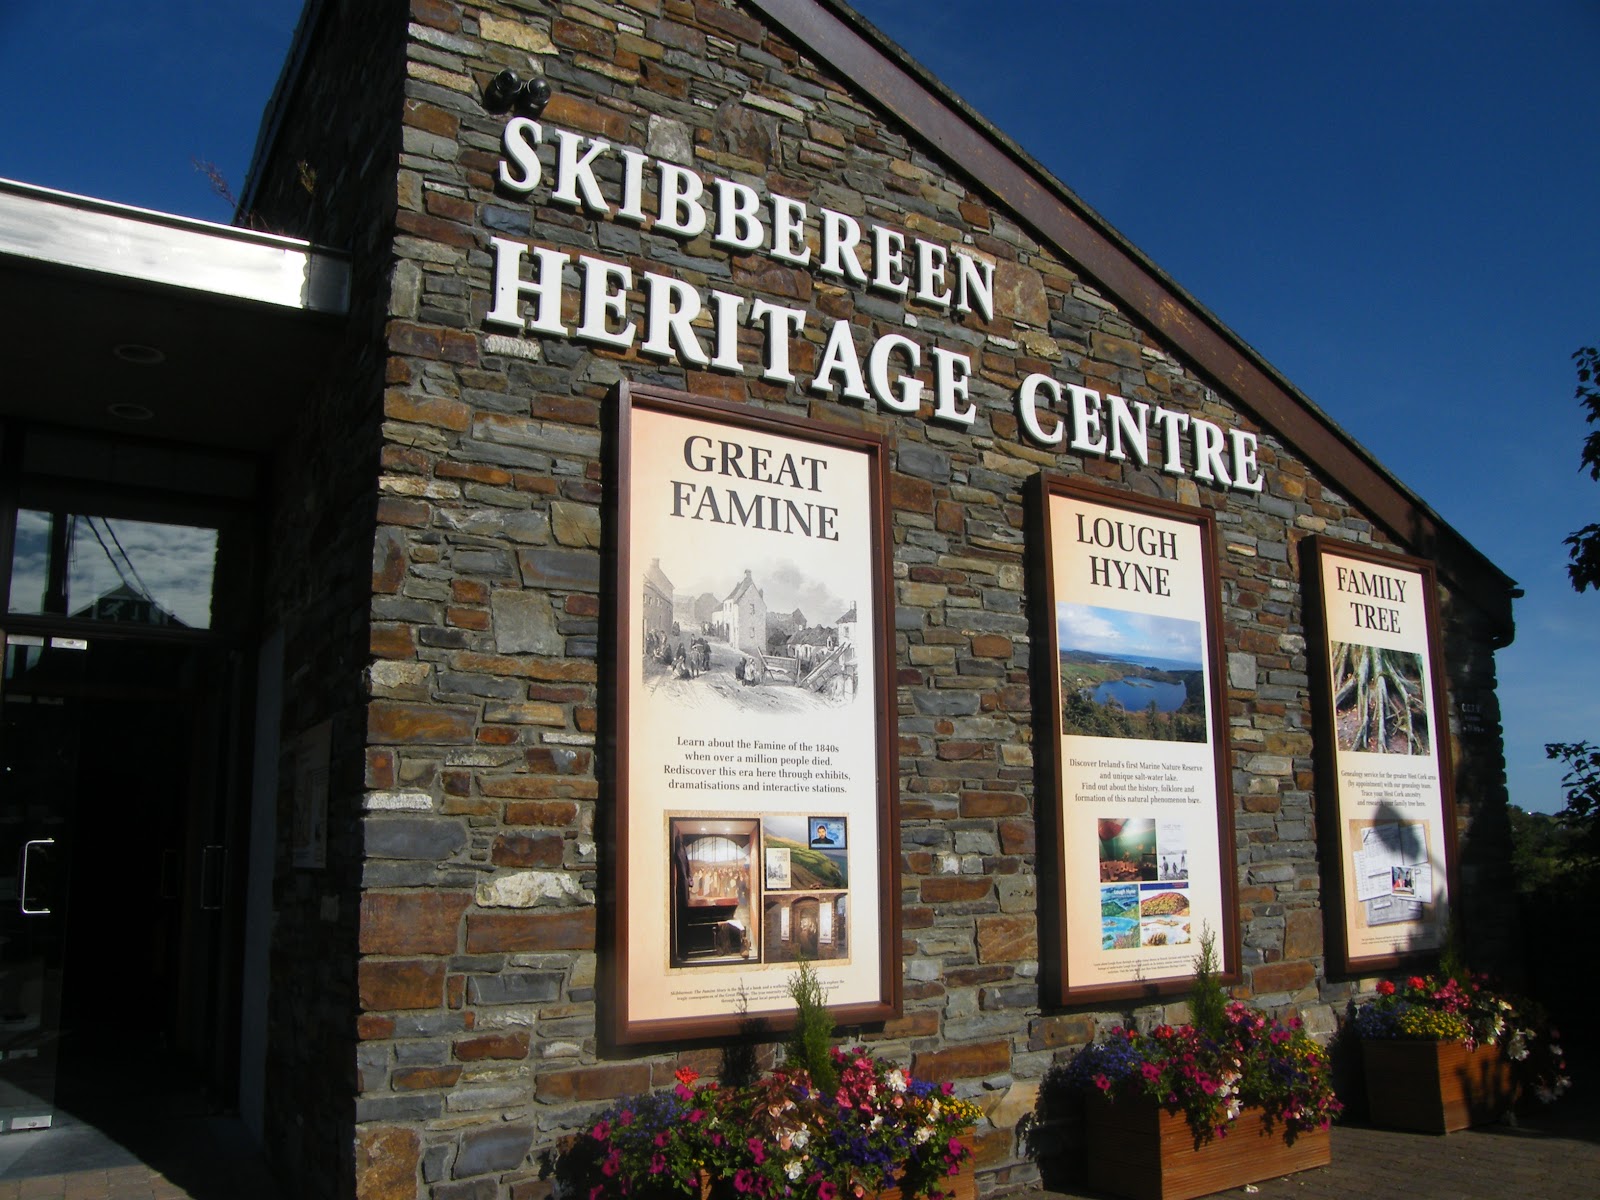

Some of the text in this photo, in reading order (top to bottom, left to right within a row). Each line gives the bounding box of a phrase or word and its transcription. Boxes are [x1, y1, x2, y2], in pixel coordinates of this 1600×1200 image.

[499, 116, 996, 322] SKIBBEREEN
[486, 235, 1263, 492] HERITAGE CENTRE
[683, 435, 828, 493] GREAT
[670, 480, 839, 541] FAMINE
[1075, 513, 1179, 560] LOUGH
[1089, 555, 1171, 597] HYNE
[1336, 566, 1407, 603] FAMILY
[1350, 601, 1401, 634] TREE
[677, 737, 840, 753] Learn about the Famine of the 1840s
[685, 751, 833, 767] when over a million people died.
[1069, 759, 1203, 772] Discover Ireland's first Marine Nature Reserve
[664, 765, 851, 781] Rediscover this era here through exhibits,
[1100, 772, 1111, 780] and
[1112, 773, 1133, 782] unique
[1165, 774, 1178, 782] lake.
[668, 779, 847, 793] dramatisations and interactive stations.
[1082, 782, 1096, 791] Find
[1097, 783, 1108, 791] out
[1109, 783, 1126, 791] about
[1128, 784, 1137, 792] the
[1161, 784, 1183, 792] folklore
[1184, 785, 1195, 793] and
[1075, 794, 1106, 802] formation
[1107, 794, 1114, 802] of
[1114, 794, 1126, 802] this
[1127, 794, 1149, 803] natural
[1150, 795, 1186, 805] phenomenon
